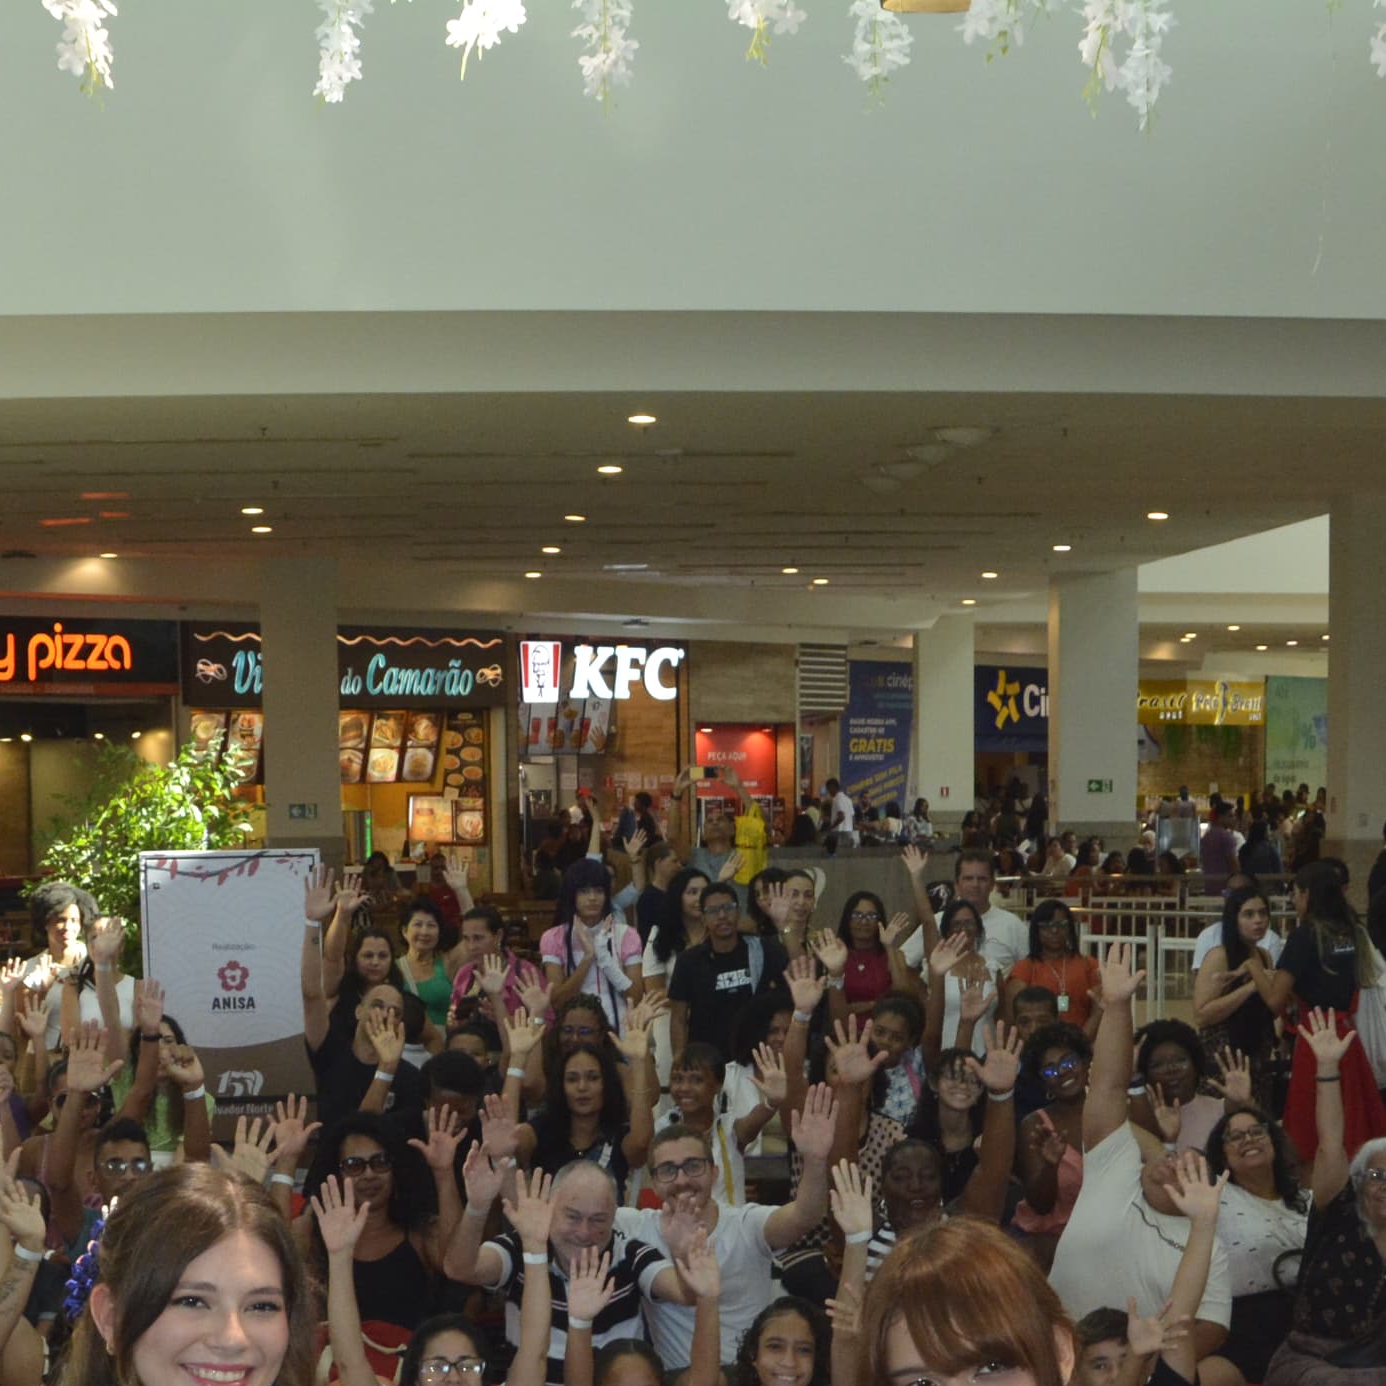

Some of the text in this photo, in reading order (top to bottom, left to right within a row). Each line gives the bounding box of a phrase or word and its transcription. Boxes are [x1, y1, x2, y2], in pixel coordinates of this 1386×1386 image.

[28, 622, 132, 681] pizza
[341, 667, 362, 696] do
[366, 652, 474, 697] Camarão
[570, 646, 681, 700] KFC
[849, 735, 895, 753] GRÁTIS
[211, 996, 256, 1010] ANISA
[246, 1102, 274, 1114] Norte
